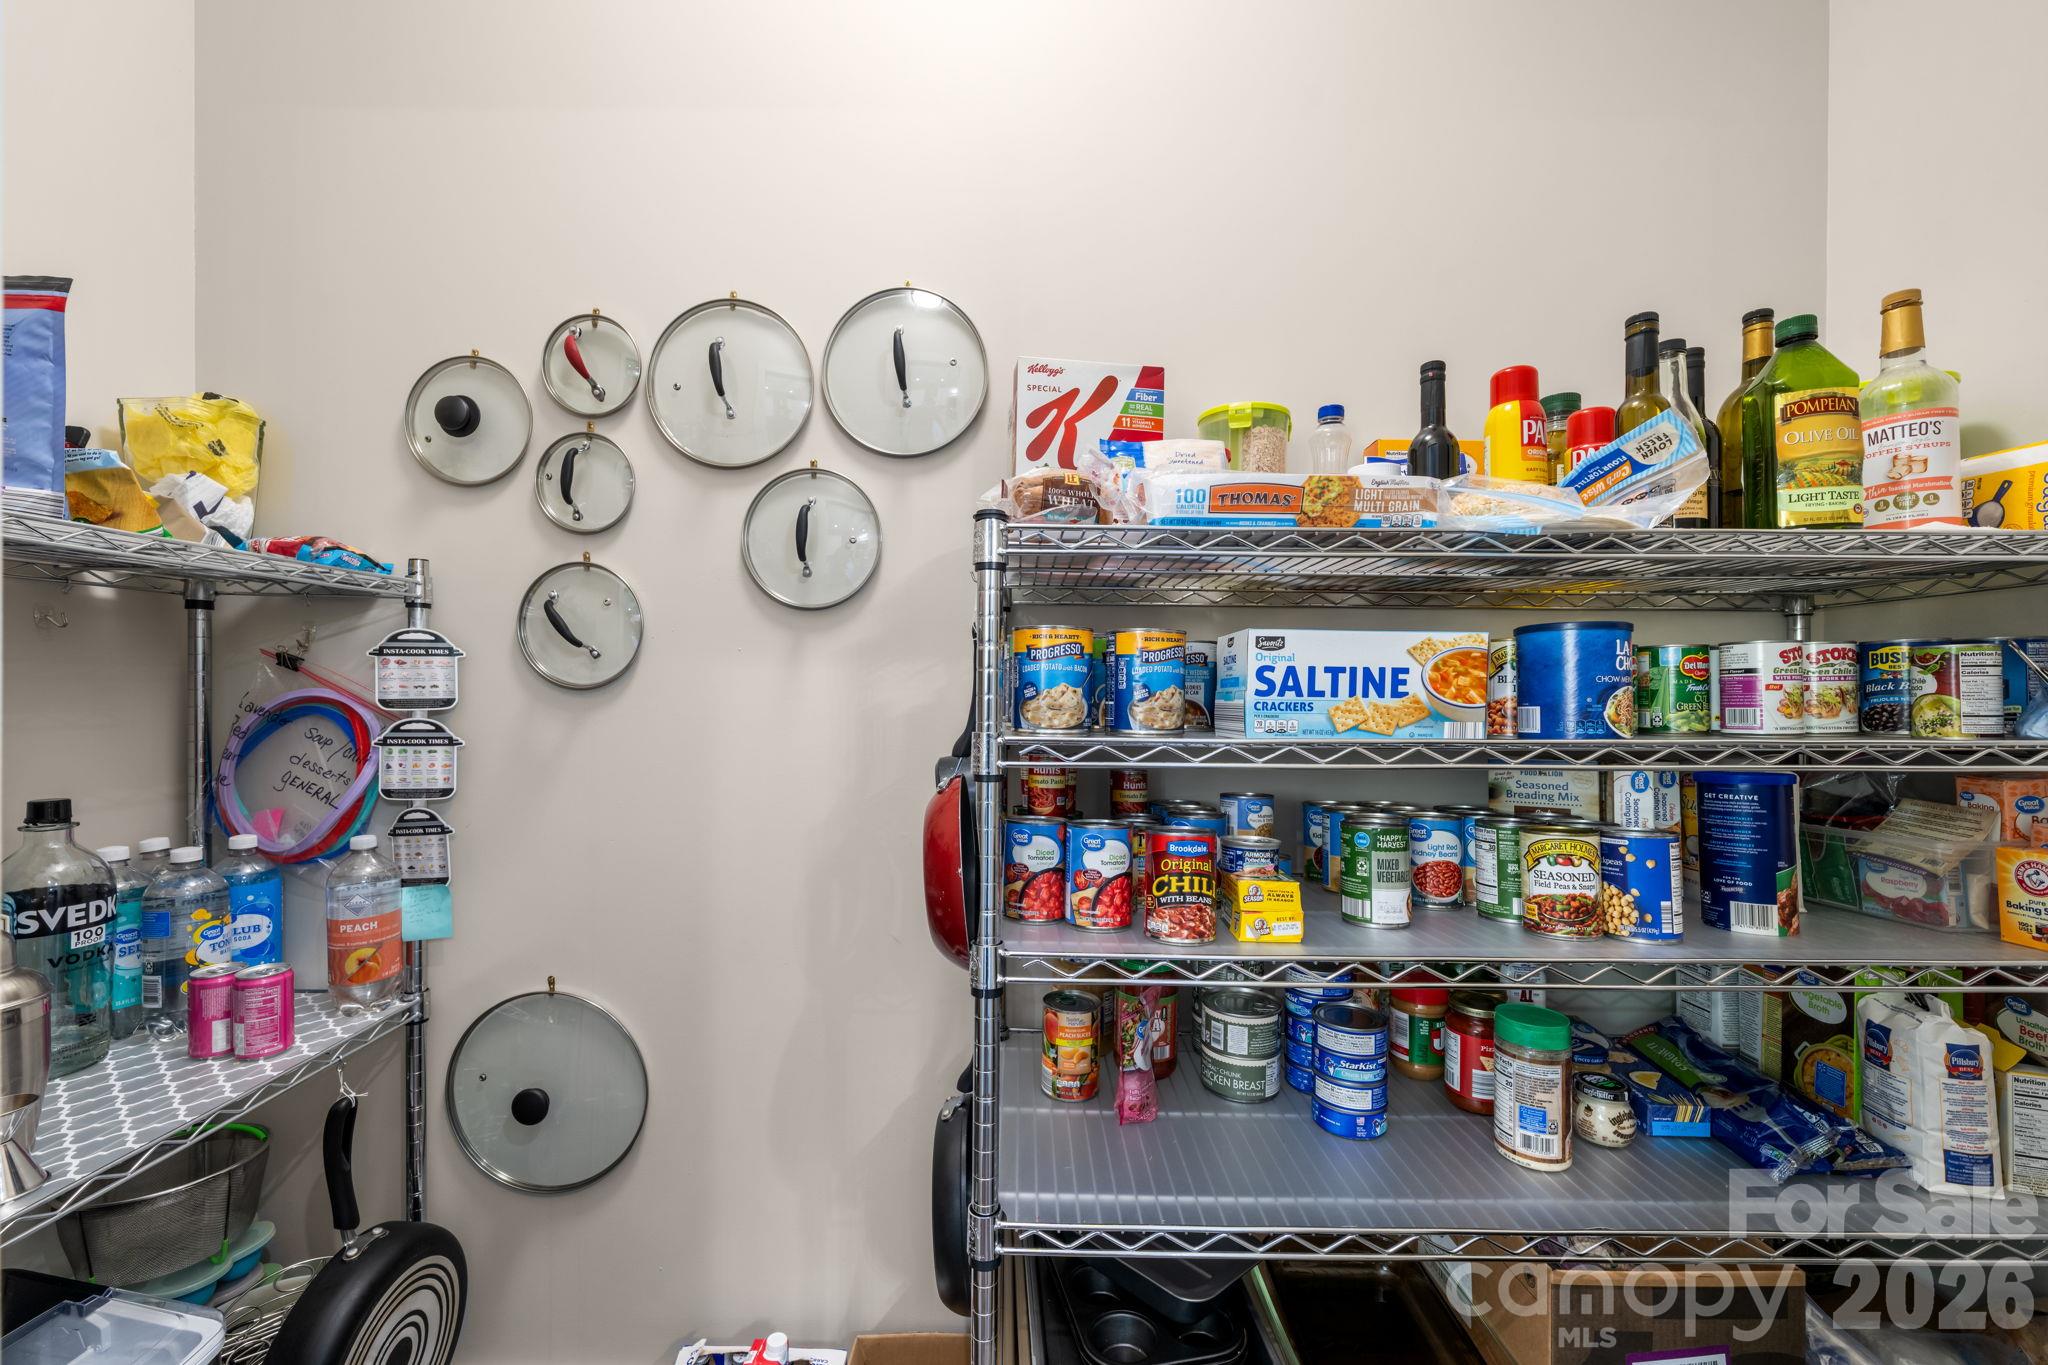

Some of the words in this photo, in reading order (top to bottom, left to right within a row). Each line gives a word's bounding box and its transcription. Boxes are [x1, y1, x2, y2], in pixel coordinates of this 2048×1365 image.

[1027, 363, 1065, 377] Kellogg's
[1027, 385, 1062, 393] SPECIAL
[1135, 392, 1158, 401] Fiber
[1136, 404, 1153, 412] REAL
[1786, 397, 1856, 418] POMPEIAN
[1025, 375, 1119, 471] K
[1121, 417, 1131, 427] 11
[1522, 419, 1547, 445] PA
[1784, 427, 1834, 445] OLIVE
[1836, 427, 1860, 441] OIL
[1868, 421, 1941, 447] MATTEO'S
[1636, 432, 1669, 454] FRESH
[1864, 447, 1901, 460] OFFEE
[1906, 441, 1951, 450] SYRUPS
[1605, 463, 1631, 486] Carb
[1371, 478, 1390, 487] English
[1048, 487, 1065, 495] 100%
[1176, 489, 1206, 503] 100
[1355, 489, 1384, 500] LIGHT
[1580, 479, 1606, 501] Wise
[1788, 490, 1830, 504] LIGHT
[1831, 490, 1860, 501] TASTE
[1353, 500, 1385, 512] MULTI
[1388, 500, 1420, 512] GRAIN
[1030, 643, 1081, 660] PROGRESSO
[1616, 639, 1630, 655] LA
[1255, 652, 1296, 664] Original
[1022, 664, 1040, 672] LOADED
[1042, 663, 1062, 671] POTATO
[1154, 665, 1173, 673] POTATO
[1253, 665, 1410, 698] SALTINE
[1595, 675, 1620, 683] CHOW
[1866, 682, 1896, 693] Black
[1254, 701, 1314, 712] CRACKERS
[1676, 702, 1702, 711] GREEN
[304, 727, 334, 750] Soup
[289, 753, 351, 786] desserts
[1516, 780, 1569, 791] Seasoned
[1506, 790, 1556, 802] Breading
[1558, 792, 1580, 802] Mix
[1624, 792, 1632, 819] Coating
[1967, 802, 1994, 811] Baking
[2018, 799, 2040, 809] Great
[1013, 832, 1029, 841] Great
[1083, 837, 1101, 845] Great
[1169, 845, 1207, 853] Brookdale
[1376, 841, 1406, 849] HARVEST
[1531, 842, 1568, 855] MARGARET
[1569, 842, 1597, 858] HOLMES
[1160, 859, 1212, 873] Original
[1377, 858, 1399, 870] MIXED
[1533, 869, 1596, 882] SEASONED
[1534, 880, 1551, 888] Field
[1578, 884, 1596, 892] Snaps
[1880, 876, 1919, 889] Raspberry
[1160, 895, 1185, 904] WITH
[1186, 895, 1212, 905] BEANS
[1244, 895, 1264, 903] SEASON
[2028, 899, 2046, 907] pure
[2006, 900, 2042, 916] Baking
[17, 895, 118, 935] SVEDK
[233, 924, 262, 936] LUB
[340, 921, 378, 933] PEACH
[2018, 920, 2033, 928] 100+
[73, 926, 104, 942] 100
[203, 926, 221, 936] Great
[74, 936, 105, 948] PROOF
[233, 934, 252, 943] SODA
[47, 944, 114, 969] VODKA
[1808, 1001, 1830, 1016] Broth
[2019, 1024, 2048, 1042] Beef
[2018, 1035, 2045, 1053] Broth
[1340, 1060, 1377, 1069] StarKist
[1951, 1056, 1980, 1067] Pillsbury
[1219, 1068, 1242, 1079] CHUNK
[1232, 1079, 1265, 1090] BREAST
[1505, 1080, 1513, 1088] 20
[2013, 1076, 2046, 1087] Nutrition
[2014, 1100, 2042, 1109] Calories
